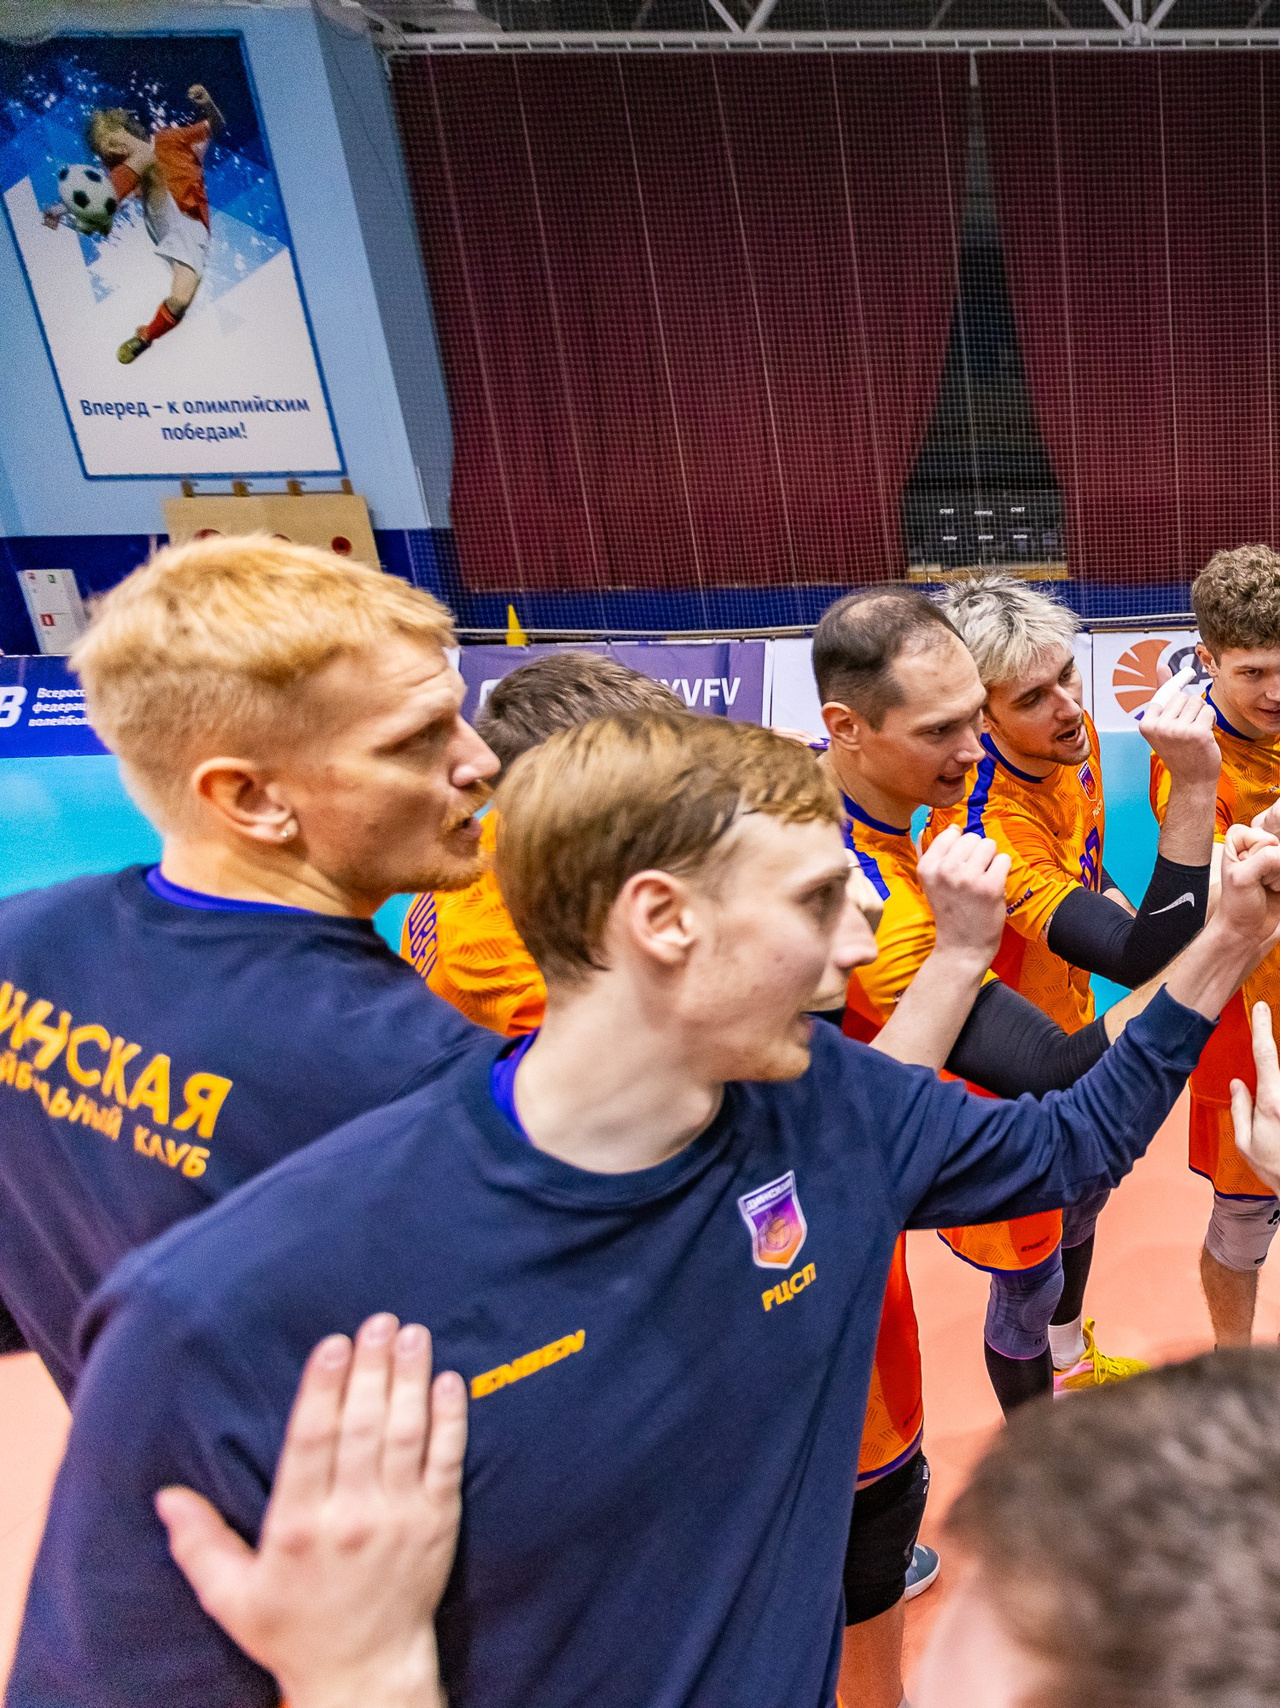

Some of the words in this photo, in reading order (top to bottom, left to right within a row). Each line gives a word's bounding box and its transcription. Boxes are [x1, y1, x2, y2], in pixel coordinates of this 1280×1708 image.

[80, 398, 150, 420] Вперед
[167, 399, 180, 415] к
[183, 395, 311, 415] олимпийским
[161, 421, 249, 442] победам!
[28, 714, 90, 727] волейбол
[0, 981, 233, 1139] ИНСКАЯ
[761, 1262, 817, 1312] РЦСП
